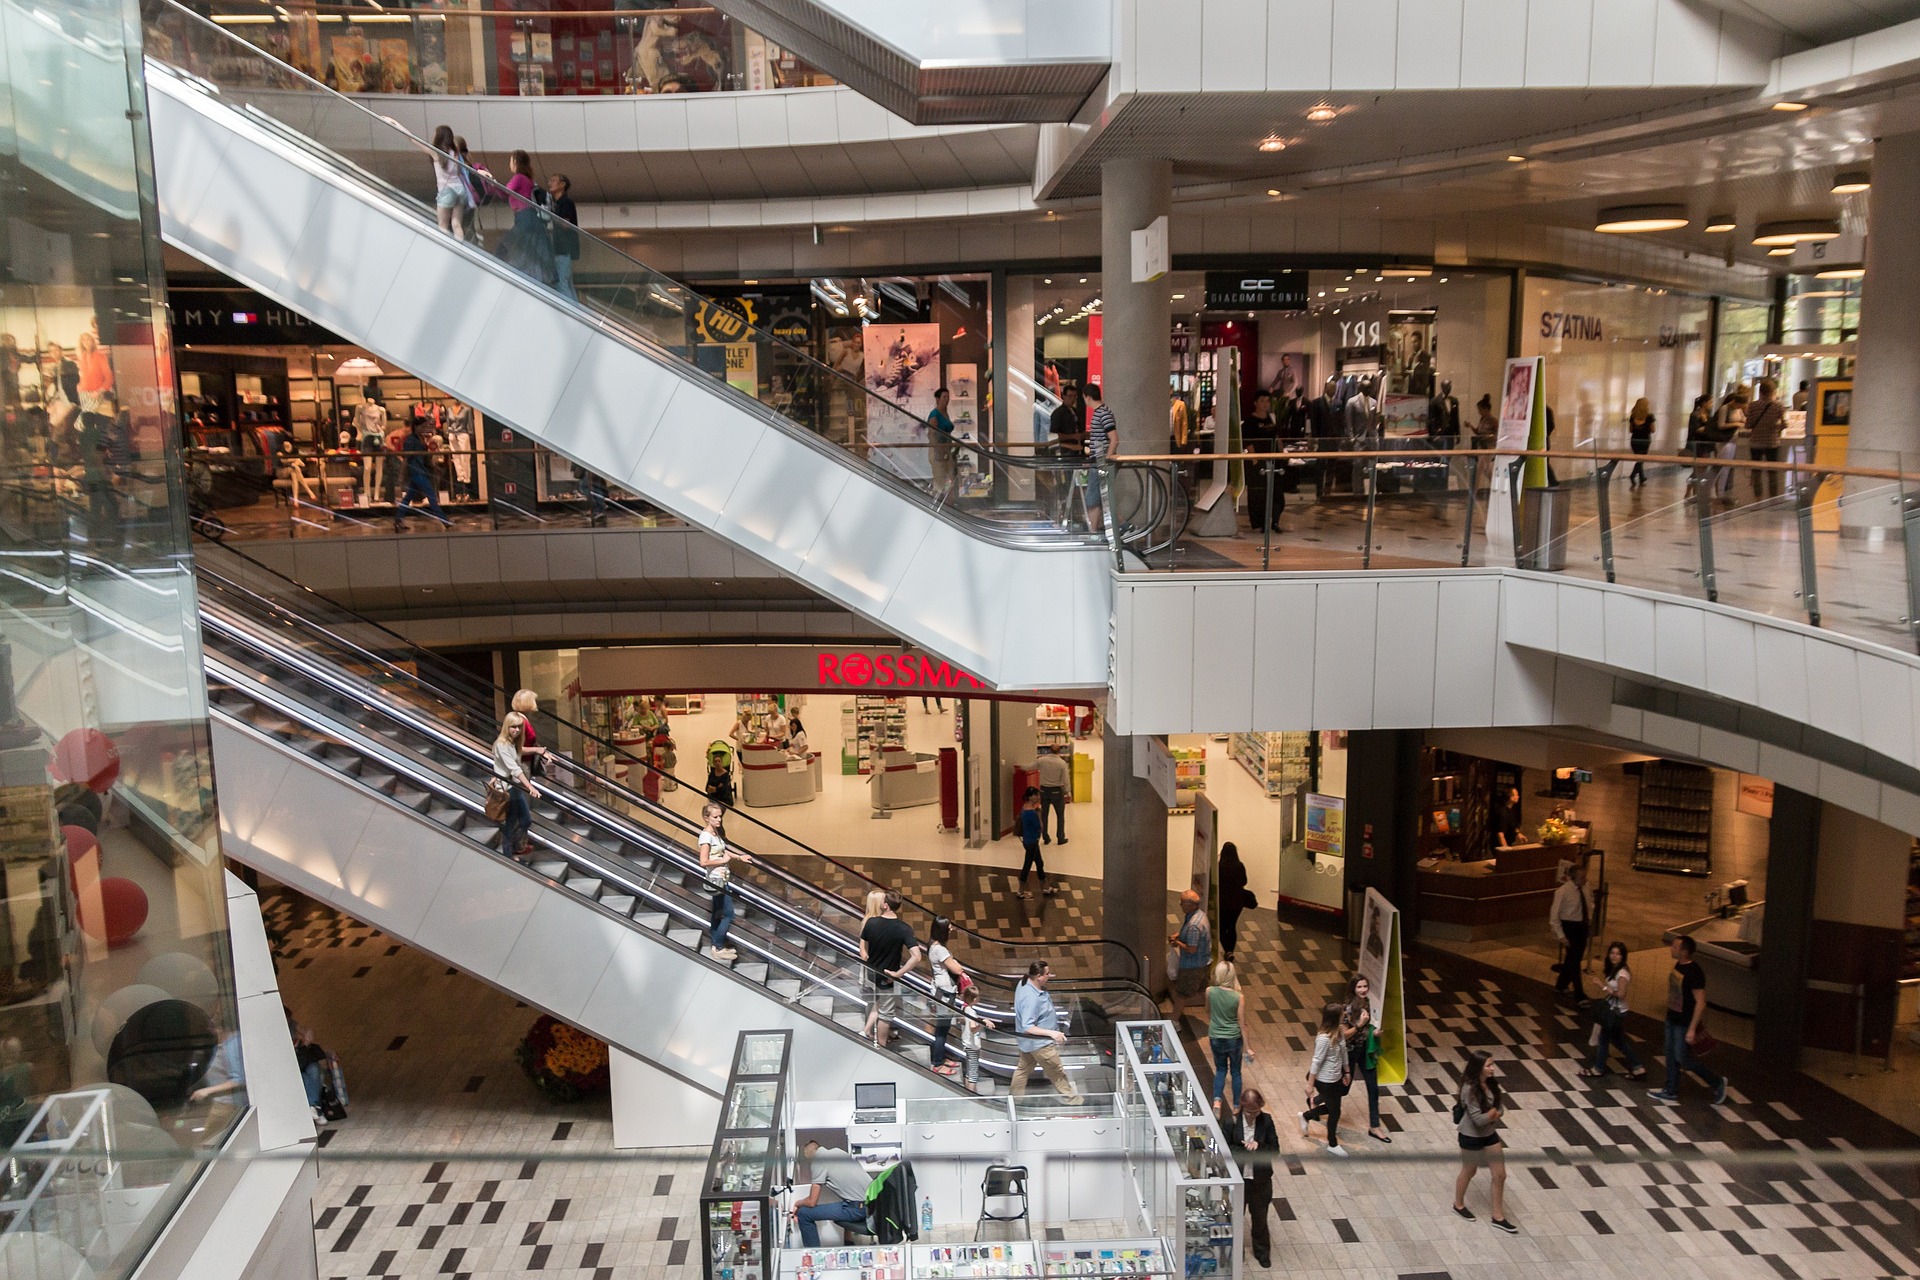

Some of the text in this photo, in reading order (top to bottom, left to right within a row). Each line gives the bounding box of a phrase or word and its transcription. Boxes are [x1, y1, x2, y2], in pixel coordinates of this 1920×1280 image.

[1210, 292, 1305, 303] GIACOMO CONTI
[171, 309, 313, 326] MY HIL
[1540, 311, 1603, 342] SZATNIA
